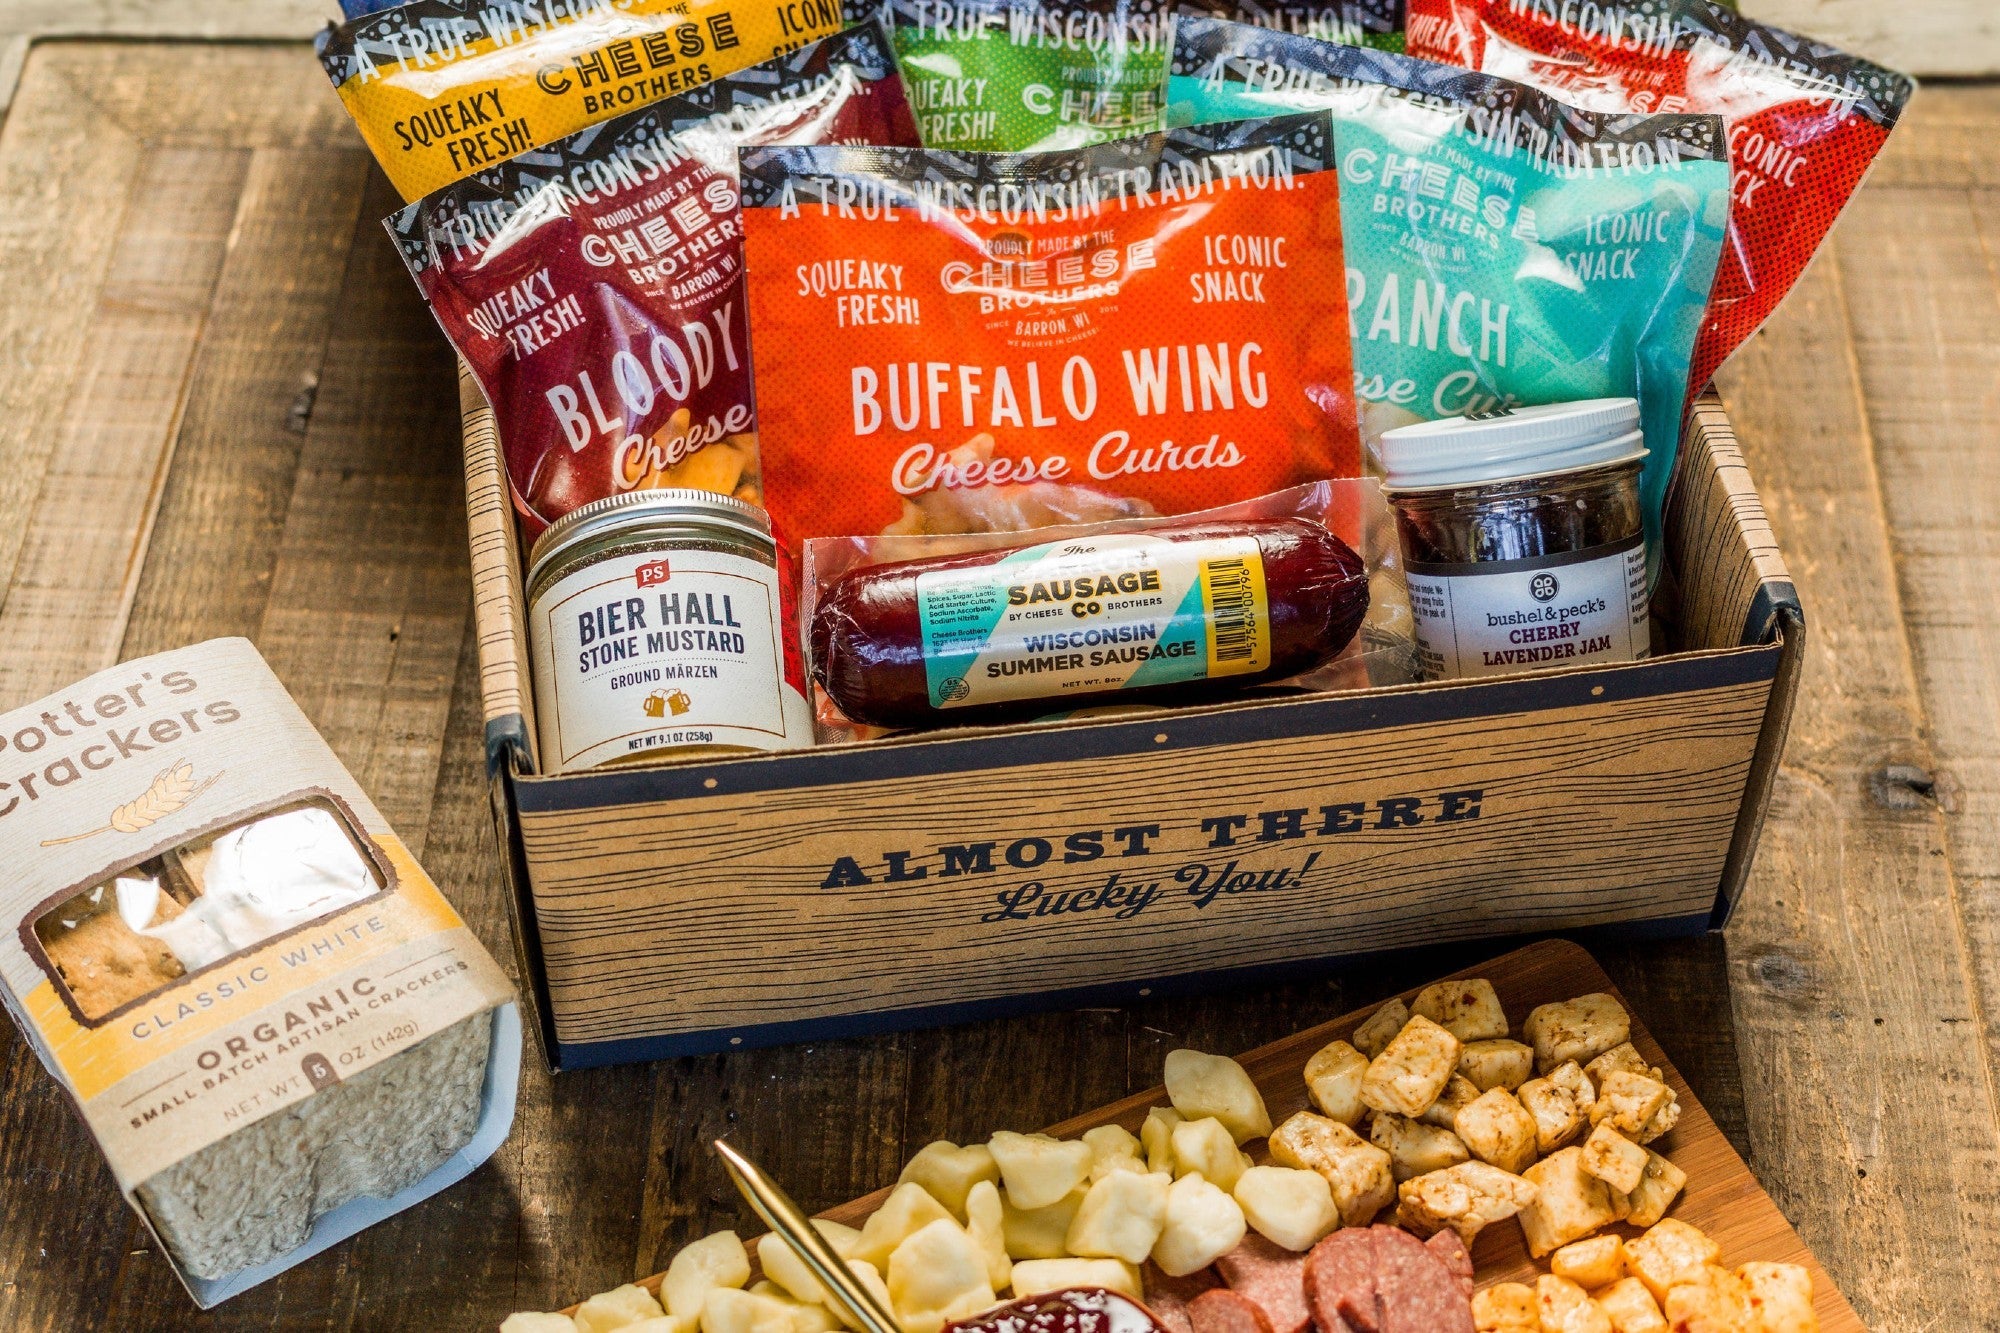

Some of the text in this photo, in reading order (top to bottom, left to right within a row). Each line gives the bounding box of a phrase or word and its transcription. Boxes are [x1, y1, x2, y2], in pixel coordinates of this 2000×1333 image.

[777, 0, 839, 37] ICONI
[915, 0, 992, 42] TRUE
[1009, 3, 1179, 54] WISCONSIN
[354, 42, 381, 85] A
[383, 16, 477, 73] TRUE
[536, 12, 740, 96] CHEESE
[584, 64, 712, 115] BROTHERS
[904, 78, 989, 111] QUEAKY
[1022, 83, 1157, 129] CHEE
[394, 88, 506, 152] SQUEAKY
[921, 111, 997, 144] FRESH!
[446, 118, 535, 172] FRESH!
[1526, 121, 1694, 179] TRADITION.
[1730, 125, 1807, 187] CONIC
[443, 201, 508, 262] TRUE
[514, 126, 695, 210] WSCONSIN
[592, 203, 644, 230] PROUDLY
[643, 187, 678, 213] MADE
[675, 176, 694, 195] BY
[780, 146, 1305, 226] A TRUE WISCONSIN TRADITION.
[1344, 148, 1540, 242] CHEESE
[581, 180, 739, 267] CHEES
[979, 231, 1116, 255] PROUDLY MADE BY THE
[1373, 194, 1500, 250] BROTHERS
[1585, 210, 1671, 247] ICONIC
[719, 254, 737, 273] WI
[941, 238, 1157, 294] CHEESE
[1205, 235, 1287, 268] ICONIC
[1564, 248, 1641, 282] SNACK
[797, 260, 903, 298] SQUEAKY
[980, 280, 1120, 315] BROTHERS
[1190, 271, 1266, 304] SNACK
[466, 268, 558, 341] SQUEAKY
[506, 294, 587, 361] FRESH!
[837, 294, 920, 328] FRESH!
[1072, 312, 1090, 329] WI
[1347, 267, 1511, 368] RANCH
[545, 302, 739, 453] BLOODY
[851, 342, 1269, 436] BUFFALO WING
[613, 404, 753, 490] Cheese
[891, 430, 1246, 495] Cheese Curds
[641, 565, 664, 583] PS
[1062, 545, 1097, 557] The
[929, 602, 944, 610] Acid
[970, 597, 997, 606] Culture,
[929, 605, 993, 618] Sodium Ascorbate,
[1007, 570, 1161, 605] SAUSAGE
[1009, 613, 1022, 622] BY
[1025, 608, 1064, 620] CHEESE
[1107, 597, 1163, 610] BROTHERS
[578, 592, 741, 647] BIER HALL
[930, 614, 979, 625] Sodium Nitrite
[932, 627, 988, 639] Cheese Brothers
[1023, 623, 1157, 653] WISCONSIN
[1508, 621, 1581, 644] CHERRY
[579, 629, 745, 674] STONE MUSTARD
[986, 641, 1197, 678] SUMMER SAUSAGE
[1482, 642, 1575, 666] LAVENDER
[1579, 635, 1611, 655] JAM
[610, 663, 718, 690] GROUND MÄRZEN
[1062, 680, 1081, 688] NET
[1084, 678, 1102, 686] WT.
[0, 671, 198, 753] otter's
[628, 731, 713, 750] NET WT 9.1 OZ (258g)
[820, 788, 1484, 890] ALMOST THERE
[980, 851, 1324, 923] Lucky You!
[131, 916, 386, 1040] CLASSIC WHITE
[130, 959, 470, 1130] SMALL BATCH ARTISAN CRACKERS
[197, 977, 377, 1072] ORGANIC
[223, 1018, 420, 1123] NET WT 5 OZ (142g)
